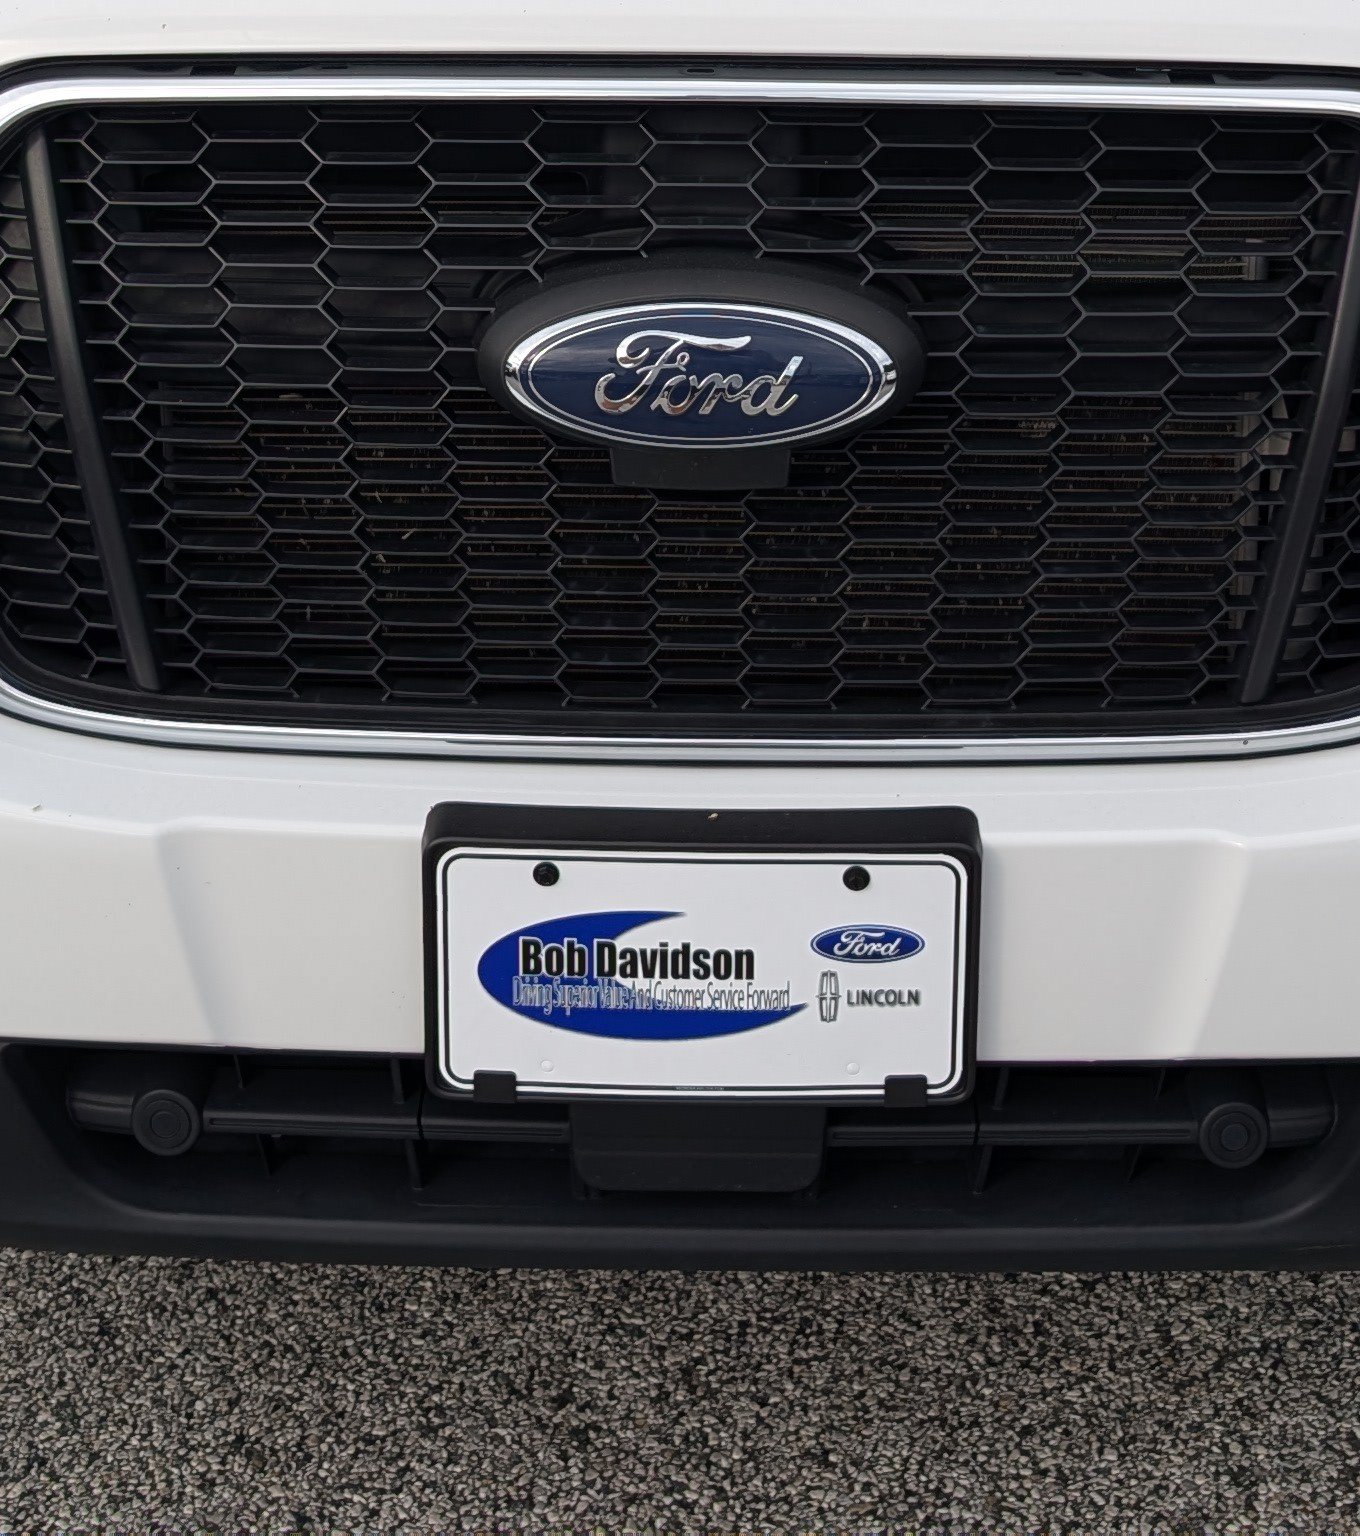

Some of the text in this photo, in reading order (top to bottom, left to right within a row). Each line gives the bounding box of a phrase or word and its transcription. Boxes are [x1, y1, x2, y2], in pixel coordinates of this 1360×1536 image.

[594, 330, 804, 416] Ford
[519, 936, 755, 981] Bob Davidson
[833, 930, 902, 956] Ford
[512, 975, 552, 1015] Driving
[630, 979, 654, 1010] And
[653, 980, 706, 1011] Customer
[706, 981, 745, 1011] Service
[746, 980, 791, 1011] Forward
[846, 989, 921, 1007] LINCOLN
